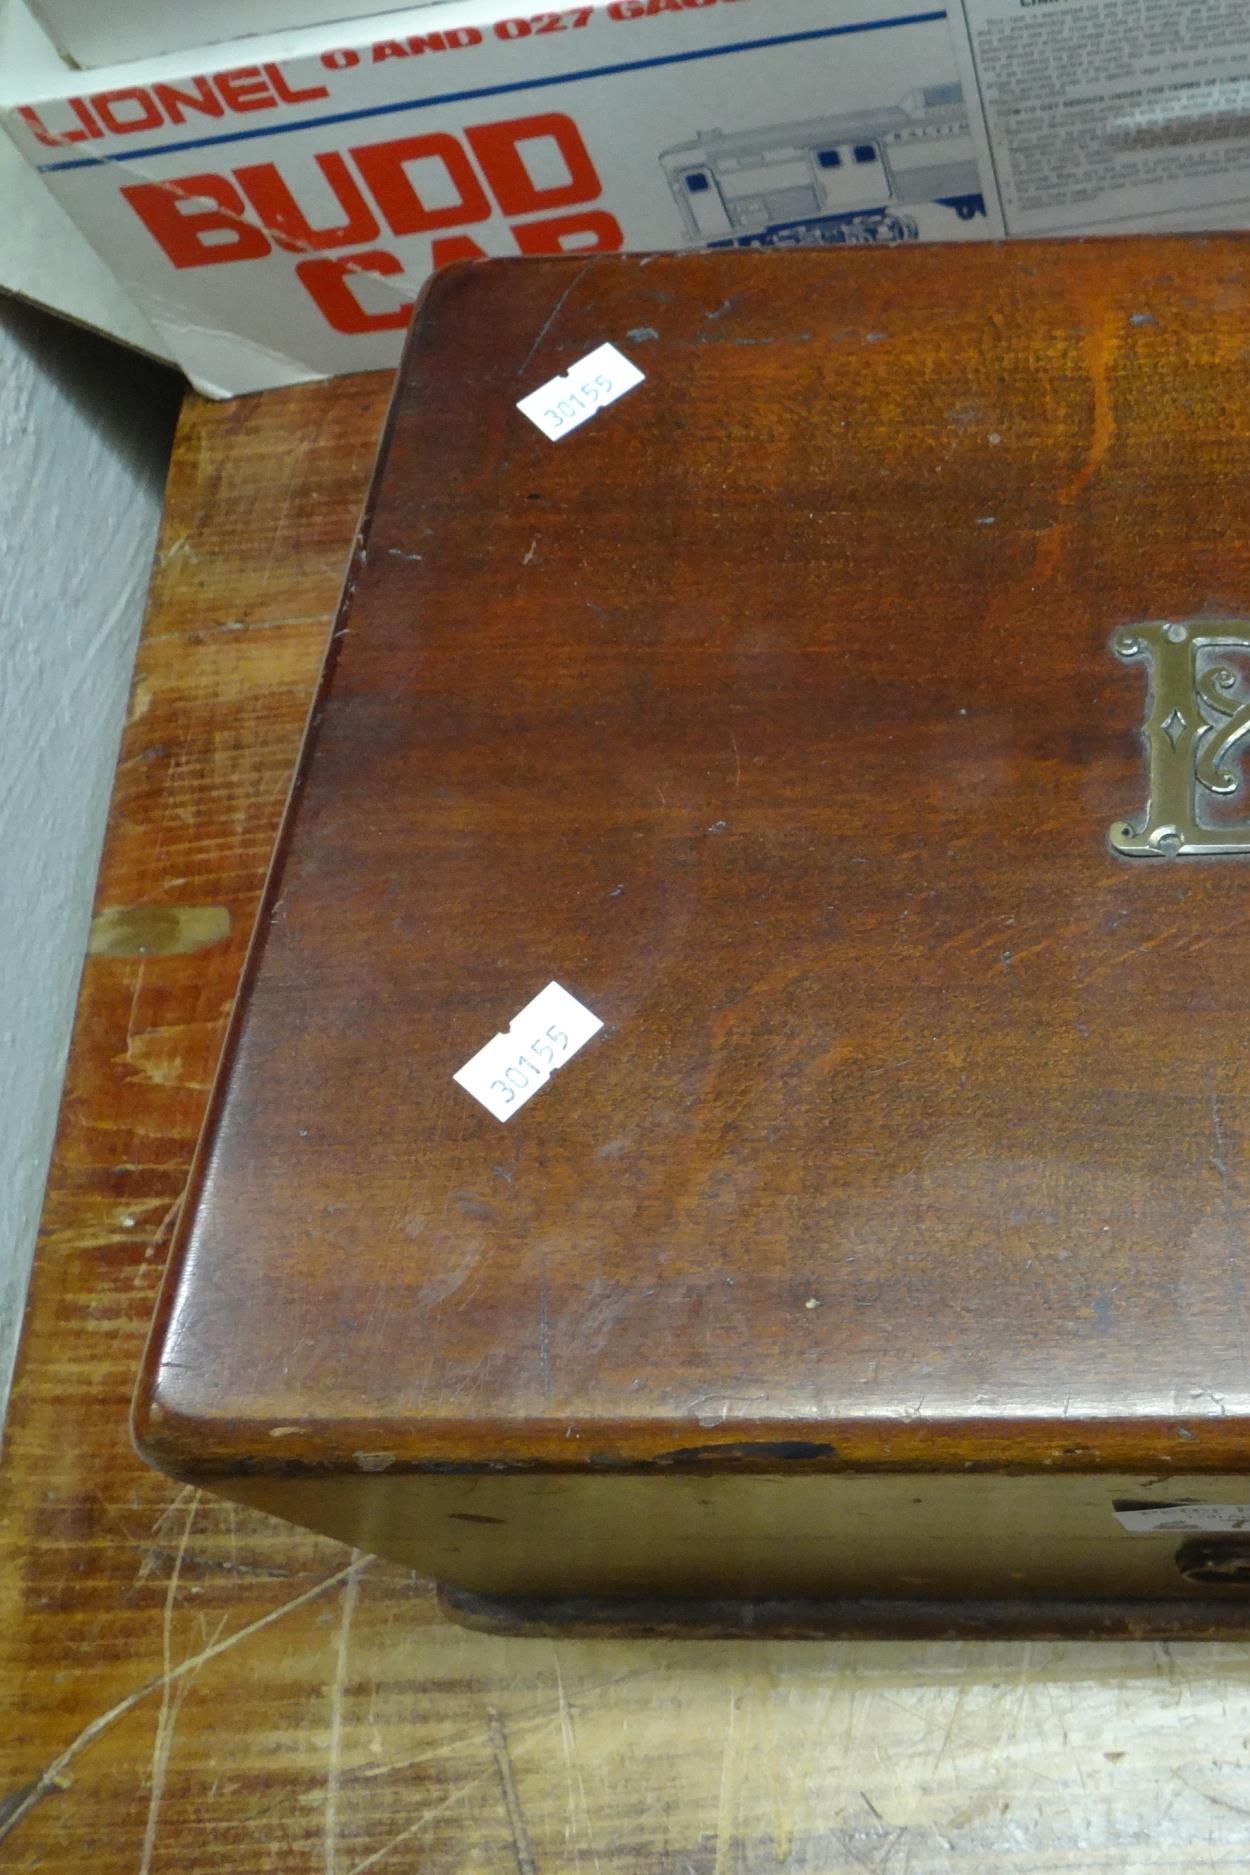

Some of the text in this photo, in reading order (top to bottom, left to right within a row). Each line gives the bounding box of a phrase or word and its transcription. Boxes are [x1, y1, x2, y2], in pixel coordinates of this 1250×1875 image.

[18, 61, 330, 147] LIONEL
[372, 25, 483, 65] AND
[119, 112, 602, 269] BUDD
[543, 374, 613, 428] 30155
[489, 1024, 569, 1104] 30155
